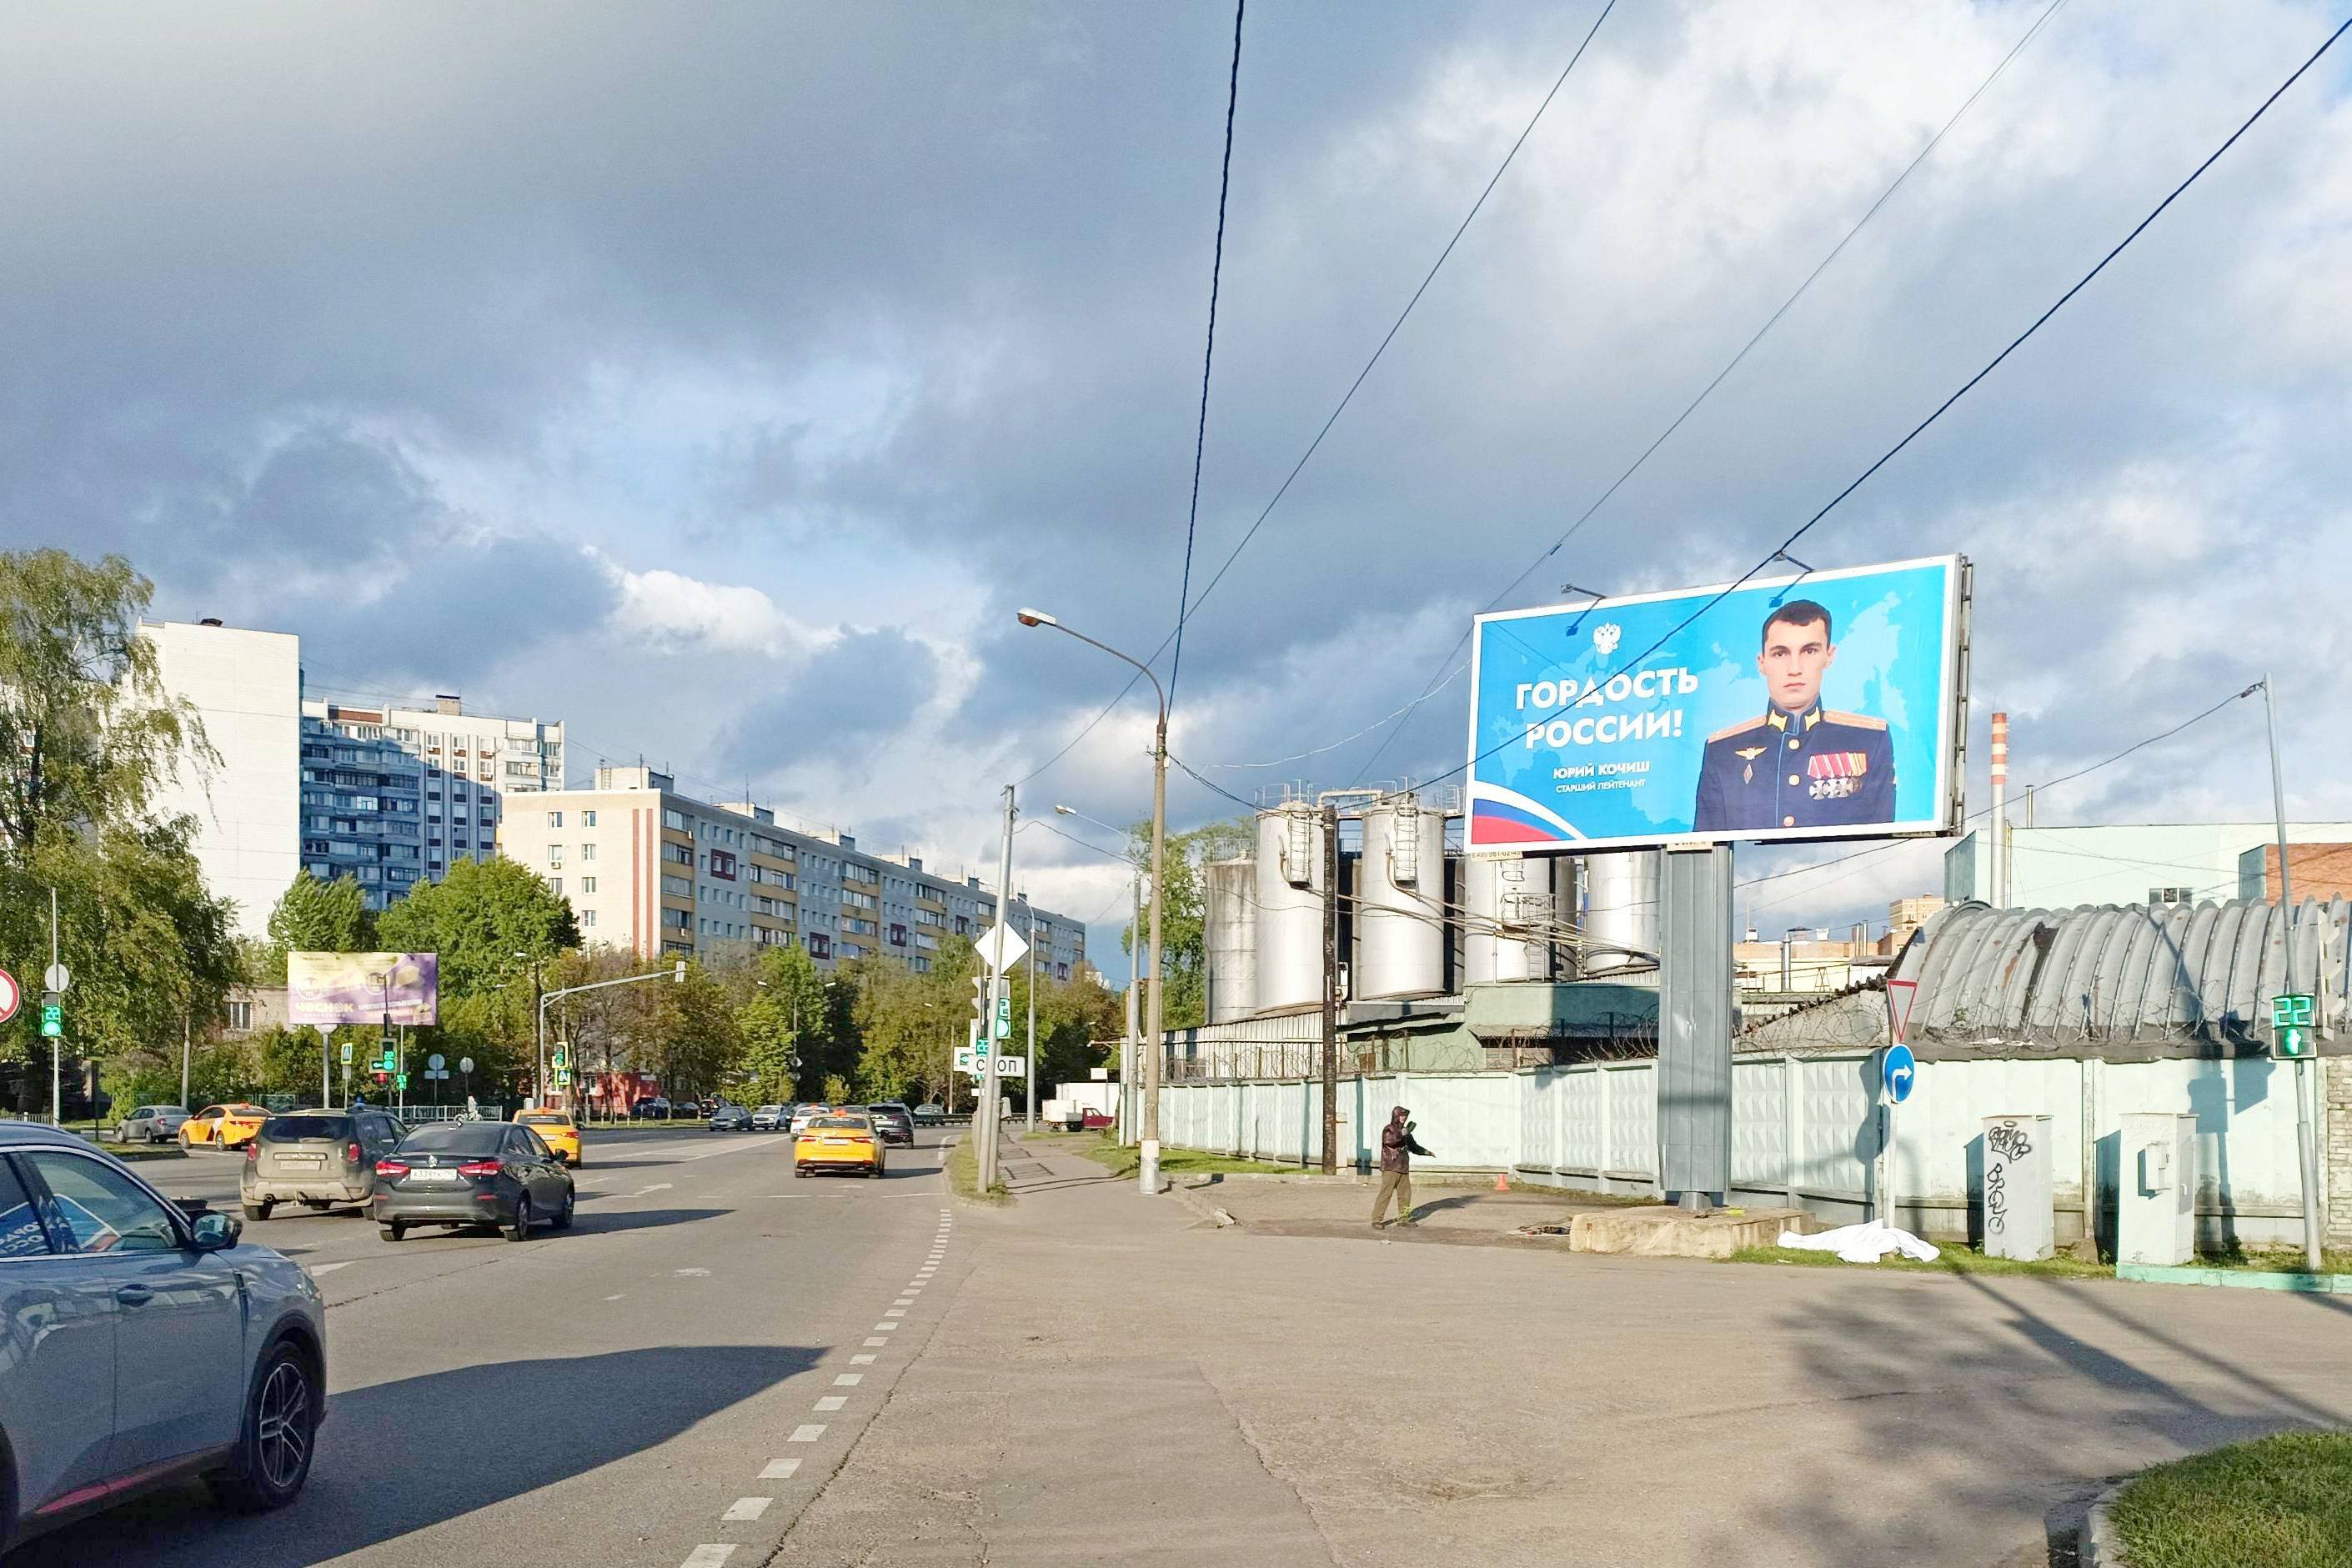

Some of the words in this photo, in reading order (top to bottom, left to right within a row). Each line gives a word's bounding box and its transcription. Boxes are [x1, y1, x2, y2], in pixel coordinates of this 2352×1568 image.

[1516, 667, 1699, 710] ГОРДОСТЬ
[1525, 709, 1683, 749] РОССИИ!
[1552, 762, 1595, 779] ЮРИЙ
[1597, 760, 1650, 776] КОЧИШ
[1556, 782, 1596, 794] СТАРШИЙ
[1597, 779, 1647, 790] ЛЕЙТЕНАНТ
[2274, 996, 2310, 1026] 22
[976, 1059, 1017, 1073] СОП
